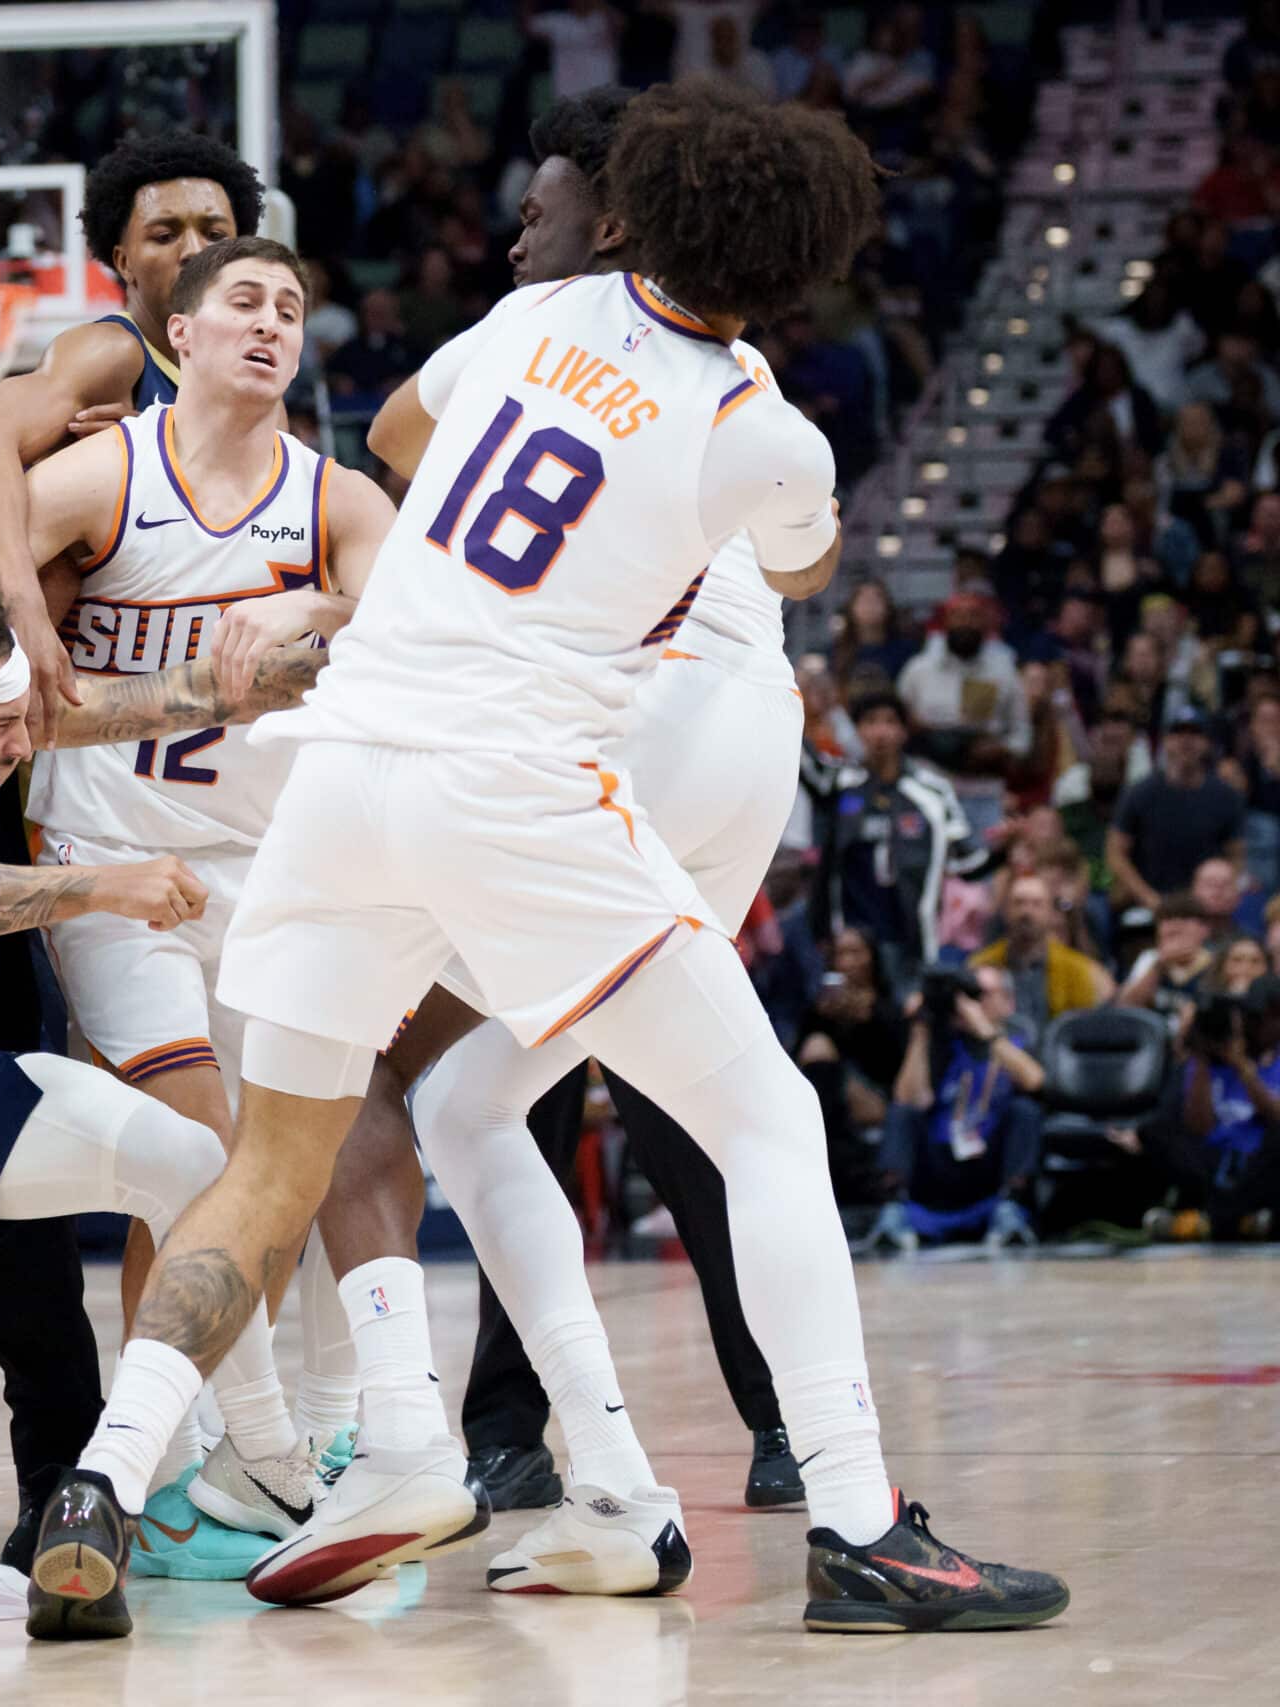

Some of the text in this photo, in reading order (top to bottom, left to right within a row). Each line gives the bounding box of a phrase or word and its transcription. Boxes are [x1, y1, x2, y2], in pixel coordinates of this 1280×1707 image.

[523, 336, 660, 440] LIVERS
[251, 523, 305, 544] PayPal
[425, 394, 607, 597] 18
[71, 602, 226, 673] SUN
